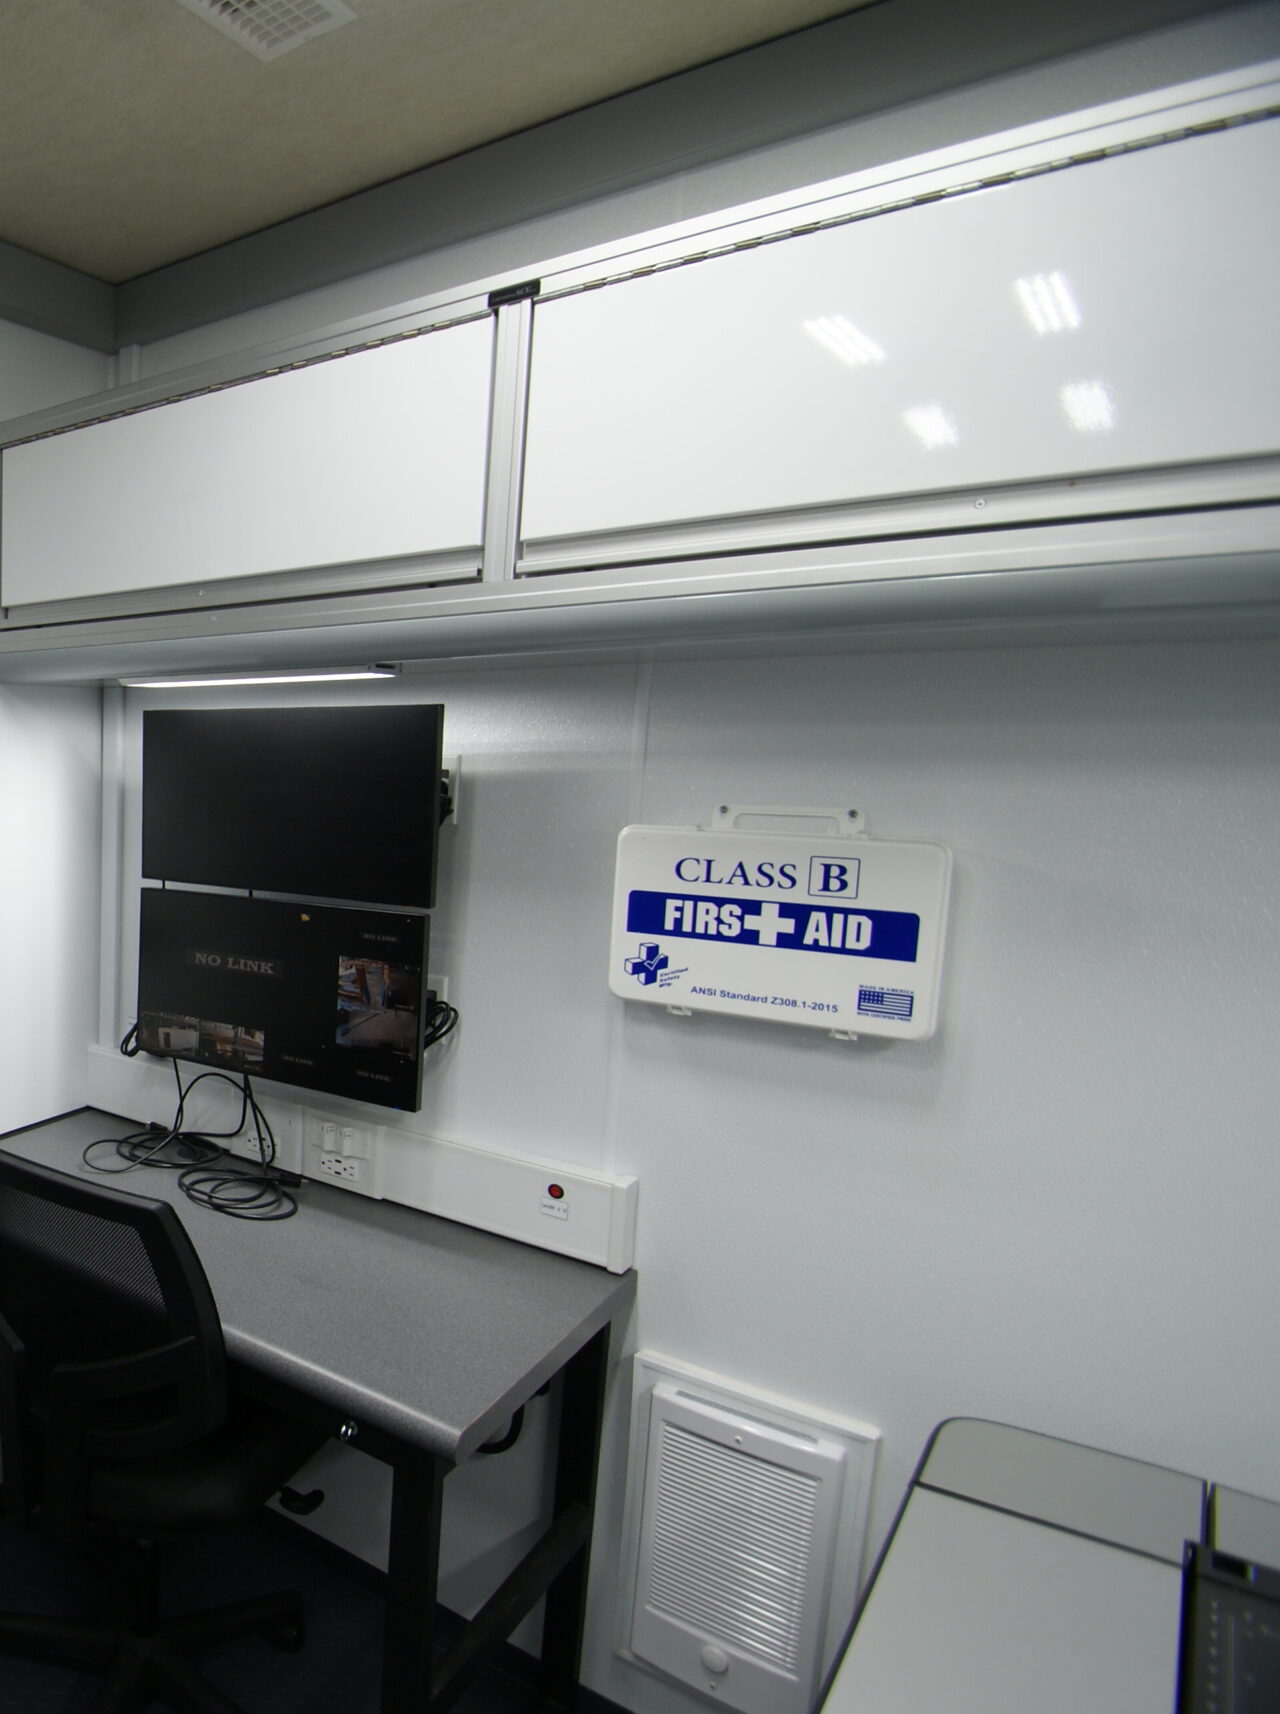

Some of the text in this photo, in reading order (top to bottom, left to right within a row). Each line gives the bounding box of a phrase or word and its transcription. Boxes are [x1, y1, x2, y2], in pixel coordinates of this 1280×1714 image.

[675, 857, 850, 893] CLASS B
[802, 911, 873, 951] AID
[195, 952, 275, 975] NO LINK
[691, 986, 838, 1013] ANSI Standard Z308.1-2015
